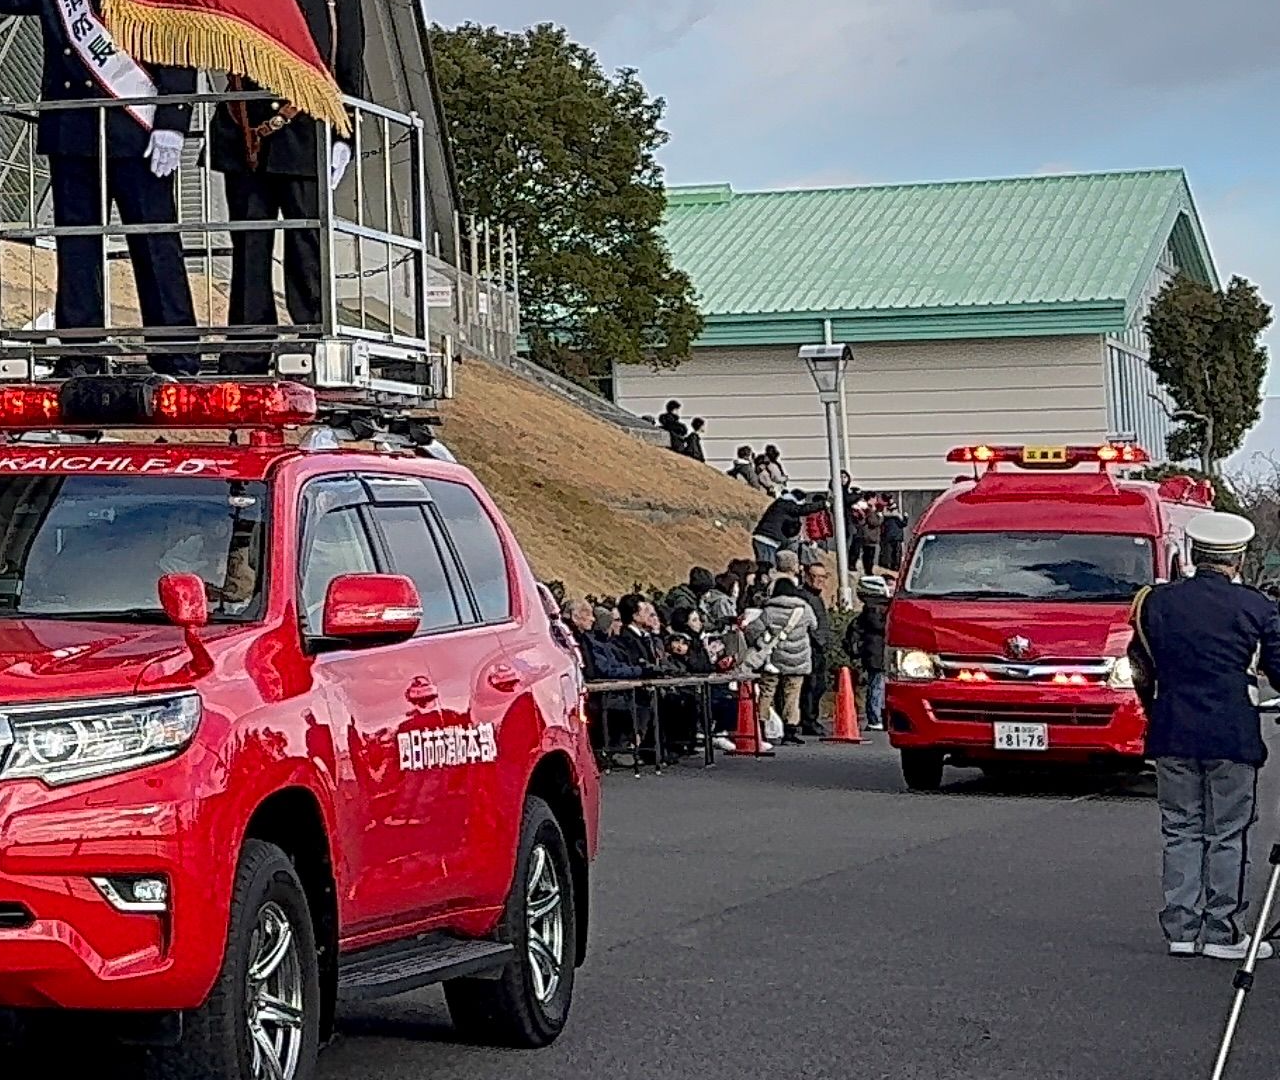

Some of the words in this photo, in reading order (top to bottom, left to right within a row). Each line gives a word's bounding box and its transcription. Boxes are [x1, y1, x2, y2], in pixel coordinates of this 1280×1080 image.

[397, 722, 498, 771] 四日市市消防本部
